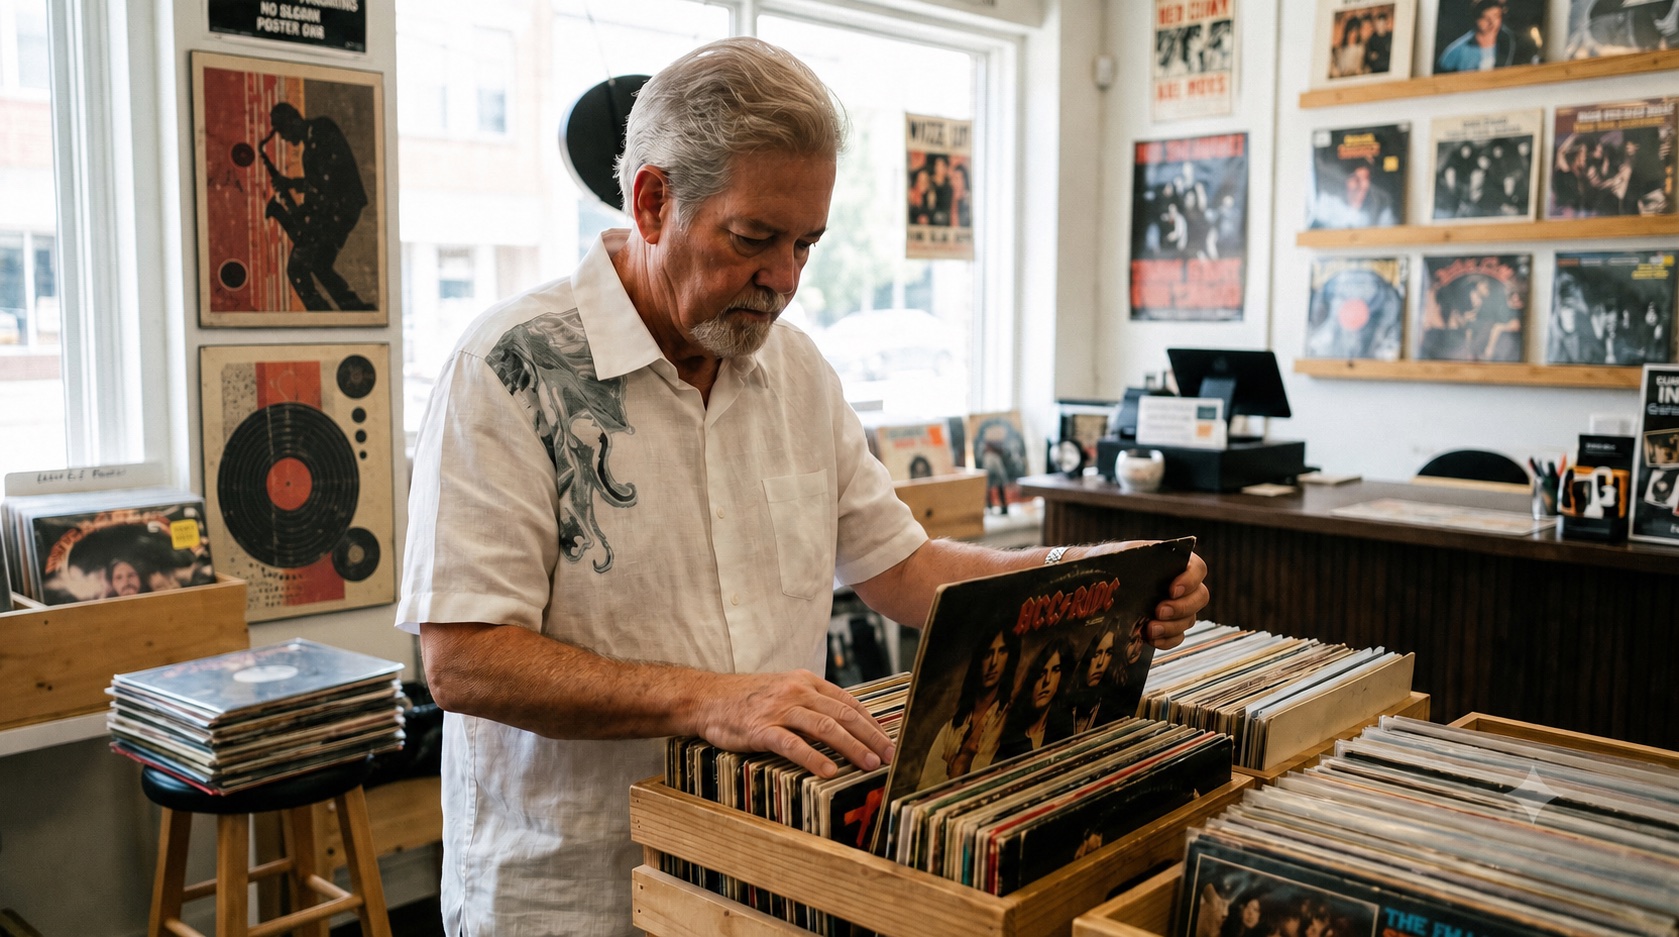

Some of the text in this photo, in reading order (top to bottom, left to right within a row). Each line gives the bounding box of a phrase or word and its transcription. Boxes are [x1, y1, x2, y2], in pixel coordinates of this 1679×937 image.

[260, 1, 278, 17] NO
[256, 17, 300, 36] POSTER
[1384, 906, 1429, 937] THE
